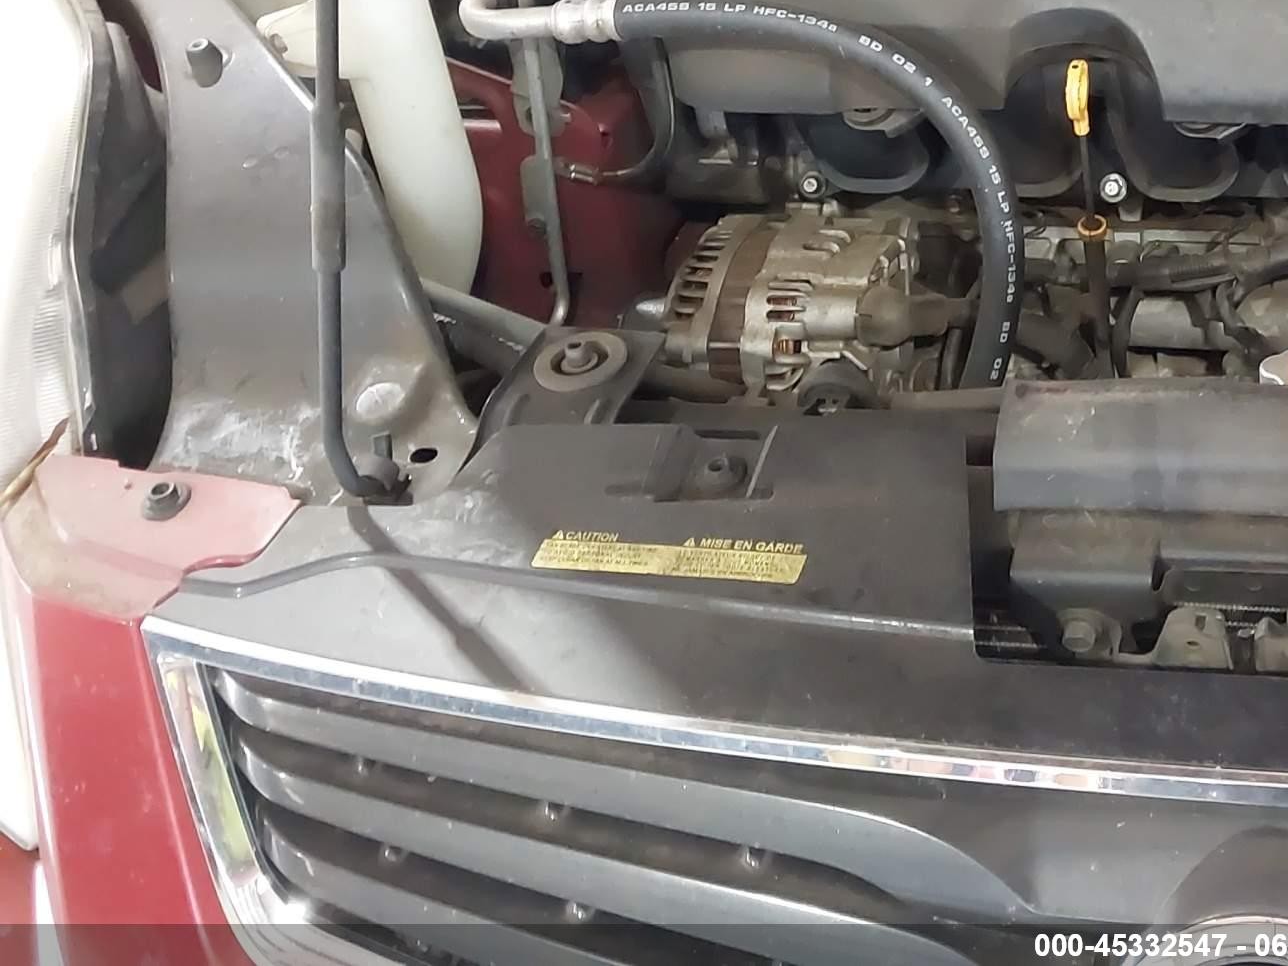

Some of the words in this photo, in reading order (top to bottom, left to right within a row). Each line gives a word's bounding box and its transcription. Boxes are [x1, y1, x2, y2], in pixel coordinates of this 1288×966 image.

[723, 3, 746, 12] LP
[752, 5, 839, 33] HFC-134a
[988, 164, 1002, 185] 15
[997, 190, 1010, 214] LP
[565, 531, 619, 542] CAUTION
[699, 538, 732, 549] MISE
[733, 539, 753, 551] EN
[755, 541, 804, 554] GARDE
